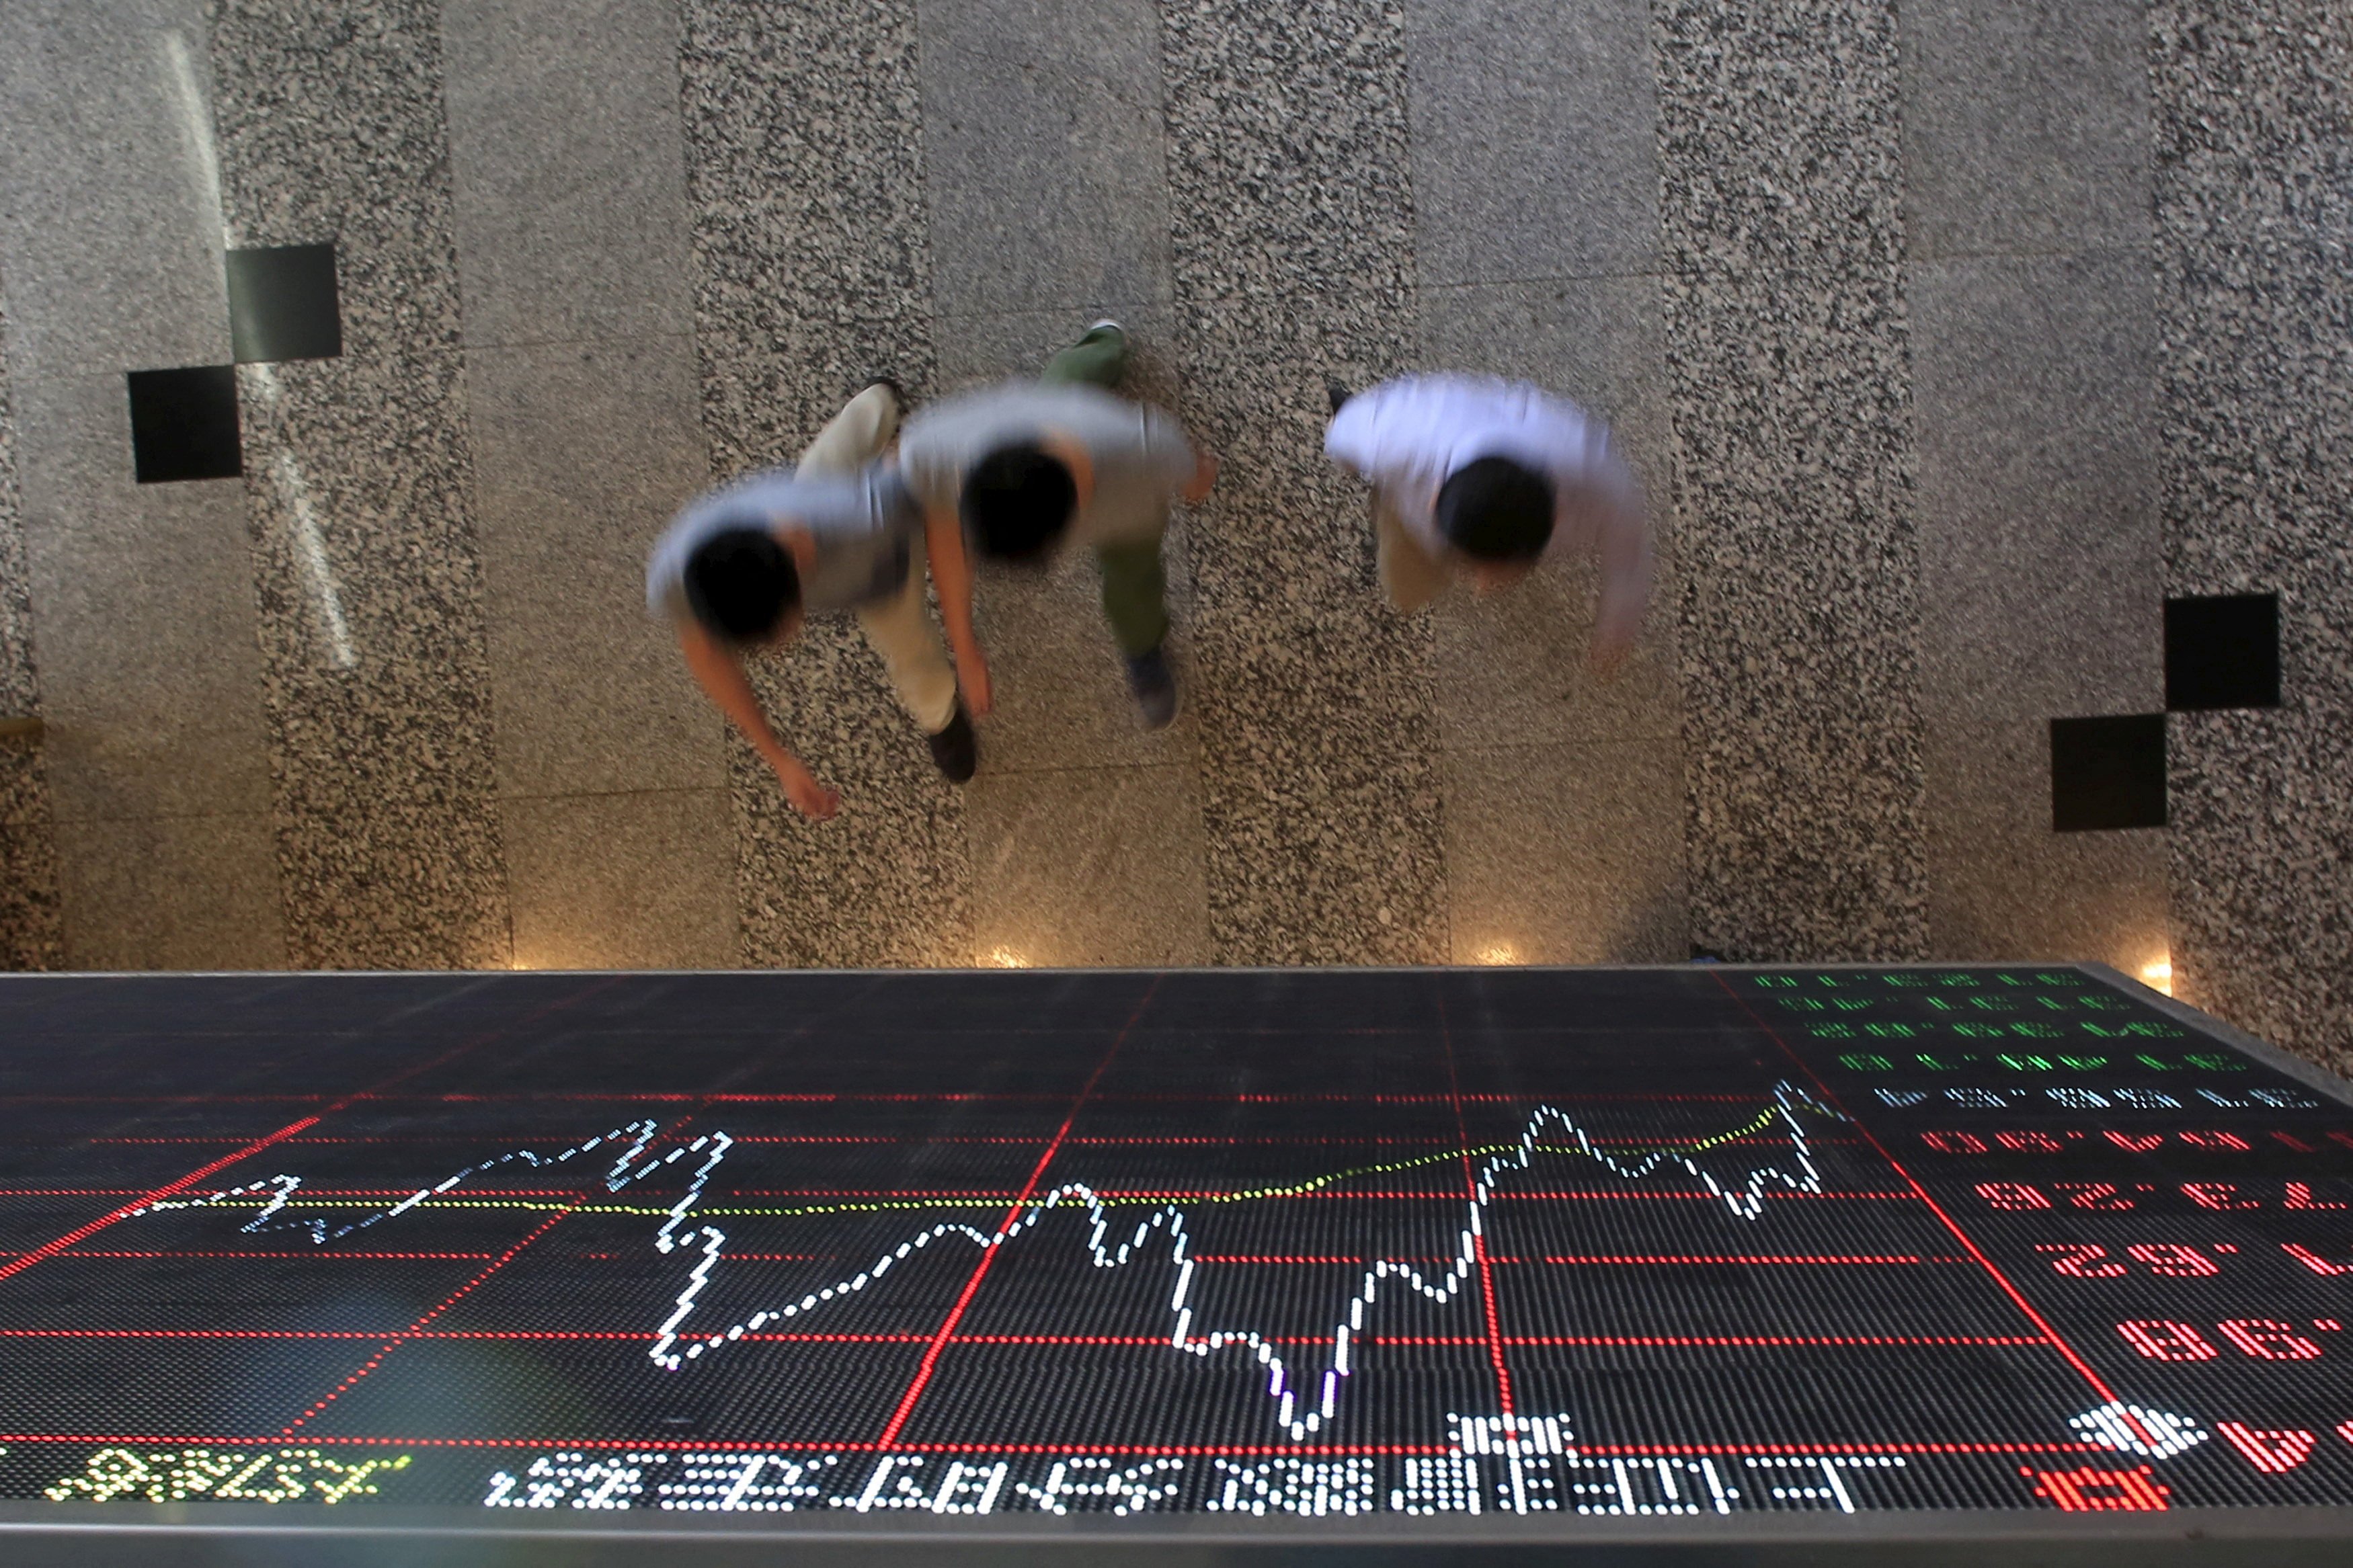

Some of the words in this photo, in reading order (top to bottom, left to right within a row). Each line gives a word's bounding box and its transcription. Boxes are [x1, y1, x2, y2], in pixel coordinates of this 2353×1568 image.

[1874, 1088, 2323, 1108] 2156.54
[1975, 1182, 2347, 1210] 73.26
[484, 1455, 1905, 1512] 上证指数分时走势
